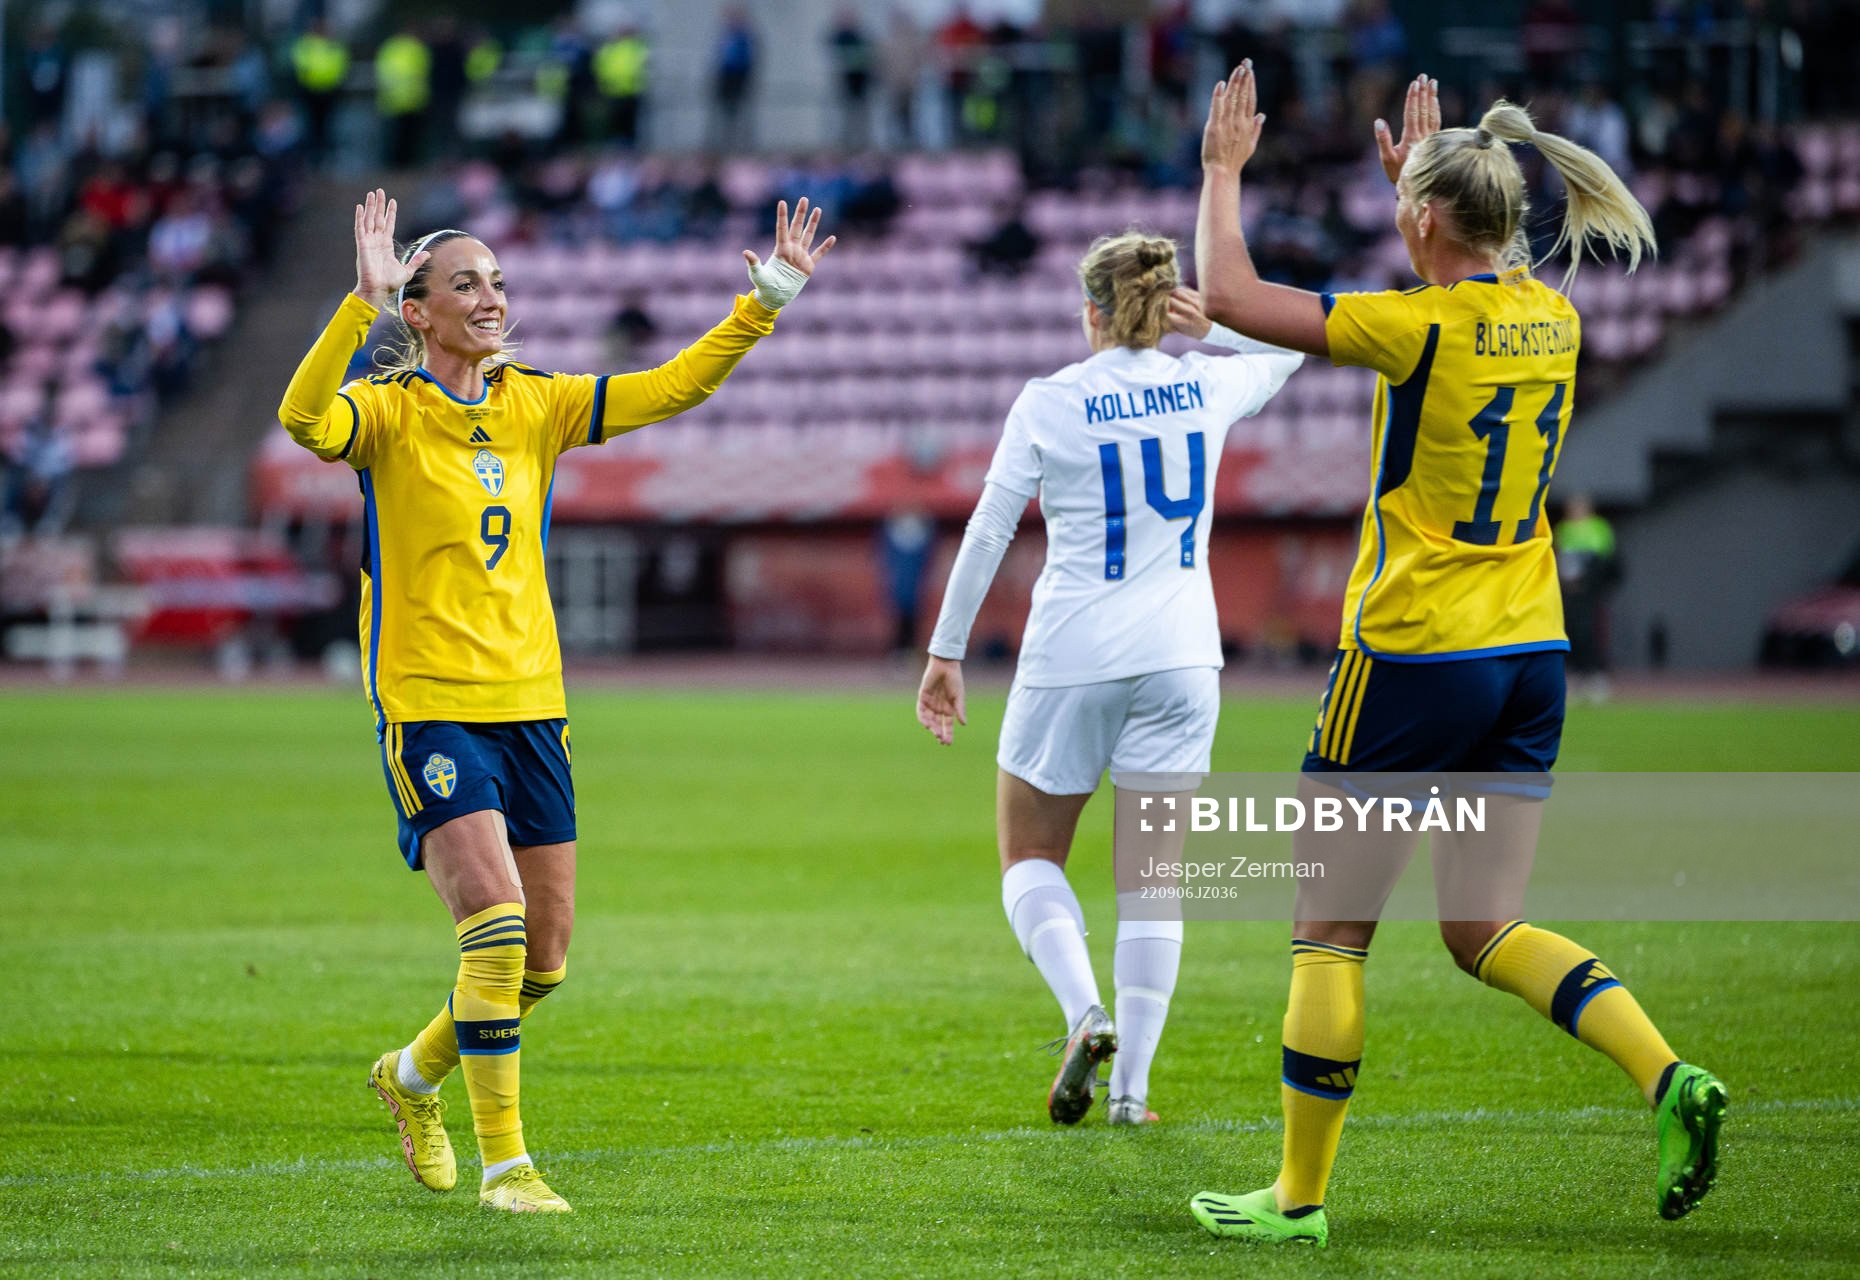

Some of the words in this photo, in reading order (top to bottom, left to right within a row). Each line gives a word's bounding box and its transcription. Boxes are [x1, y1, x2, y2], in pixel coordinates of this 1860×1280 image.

[1085, 380, 1204, 424] KOLLANEN
[1098, 431, 1206, 581] 14
[1452, 383, 1567, 545] 11
[480, 505, 512, 571] 9
